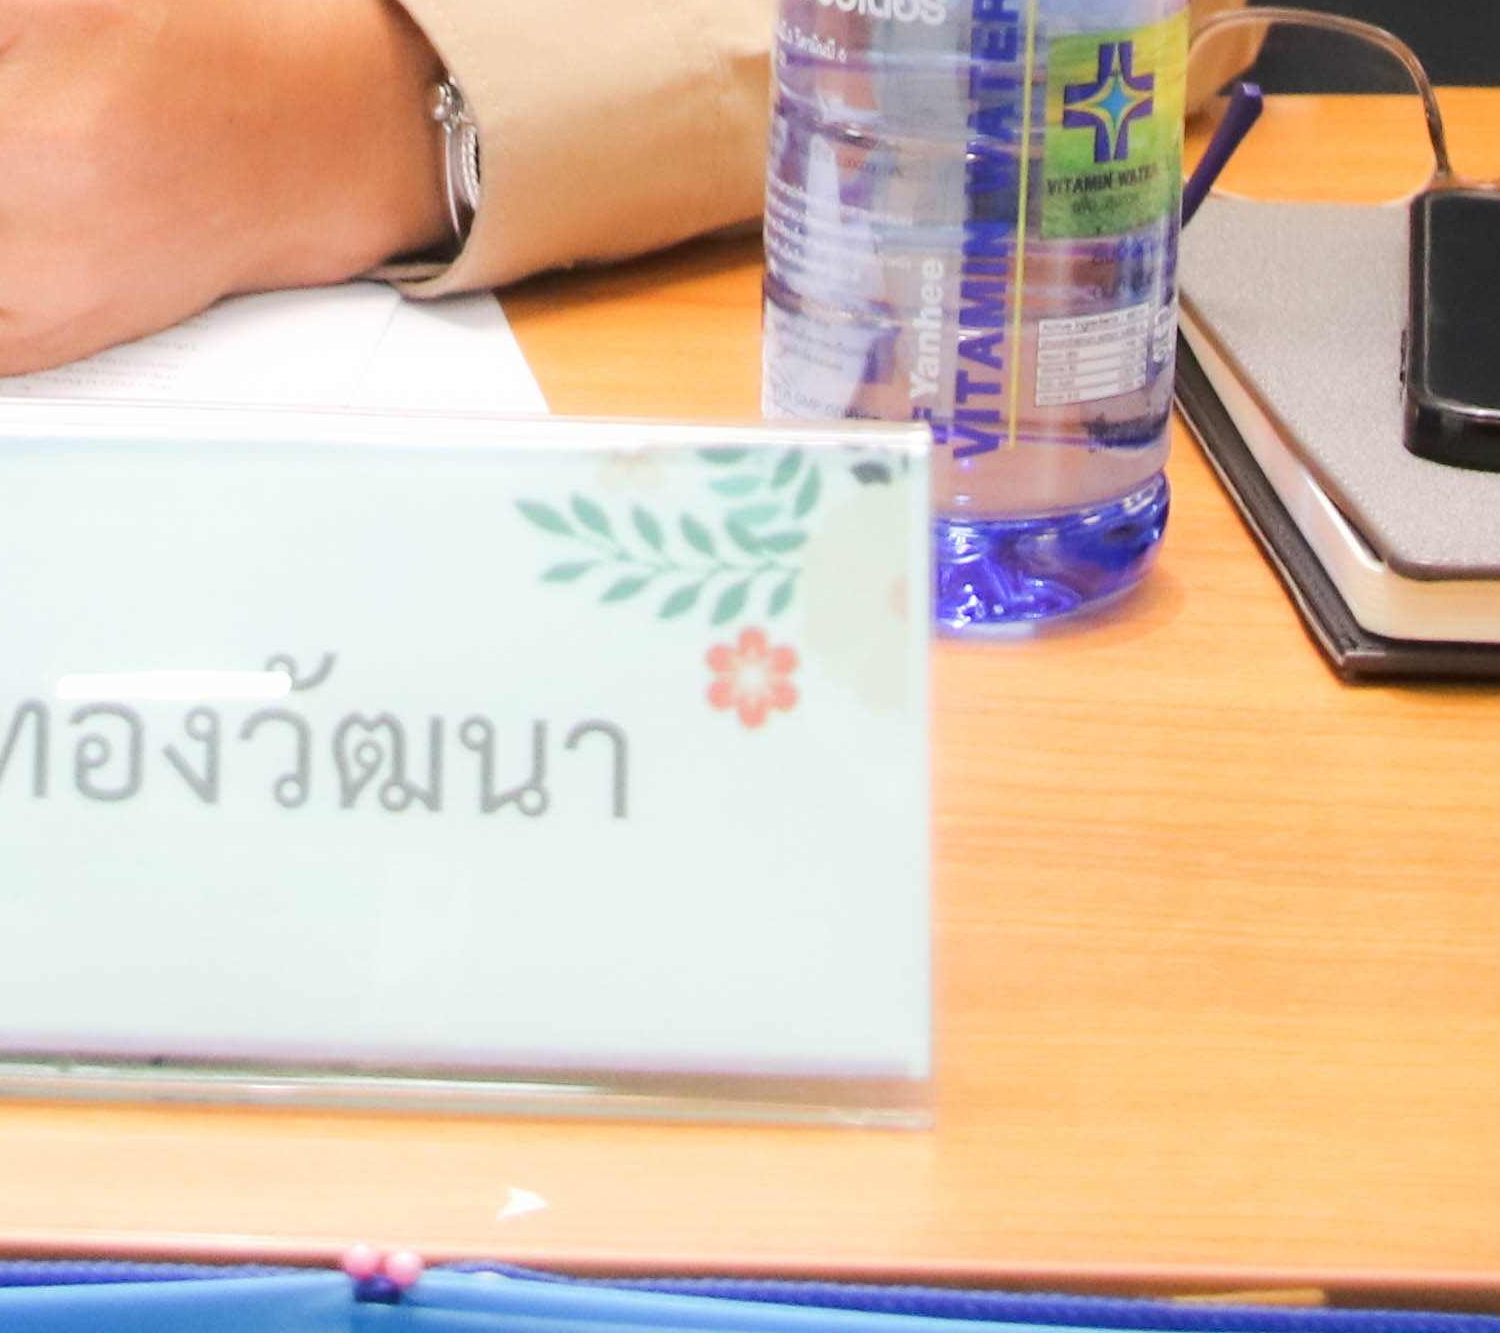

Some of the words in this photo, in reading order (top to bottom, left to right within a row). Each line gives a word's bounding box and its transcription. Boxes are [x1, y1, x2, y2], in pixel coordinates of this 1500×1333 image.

[1046, 171, 1113, 196] VITAMIN
[908, 257, 945, 400] Yanhee
[953, 219, 1010, 460] VITAMIN
